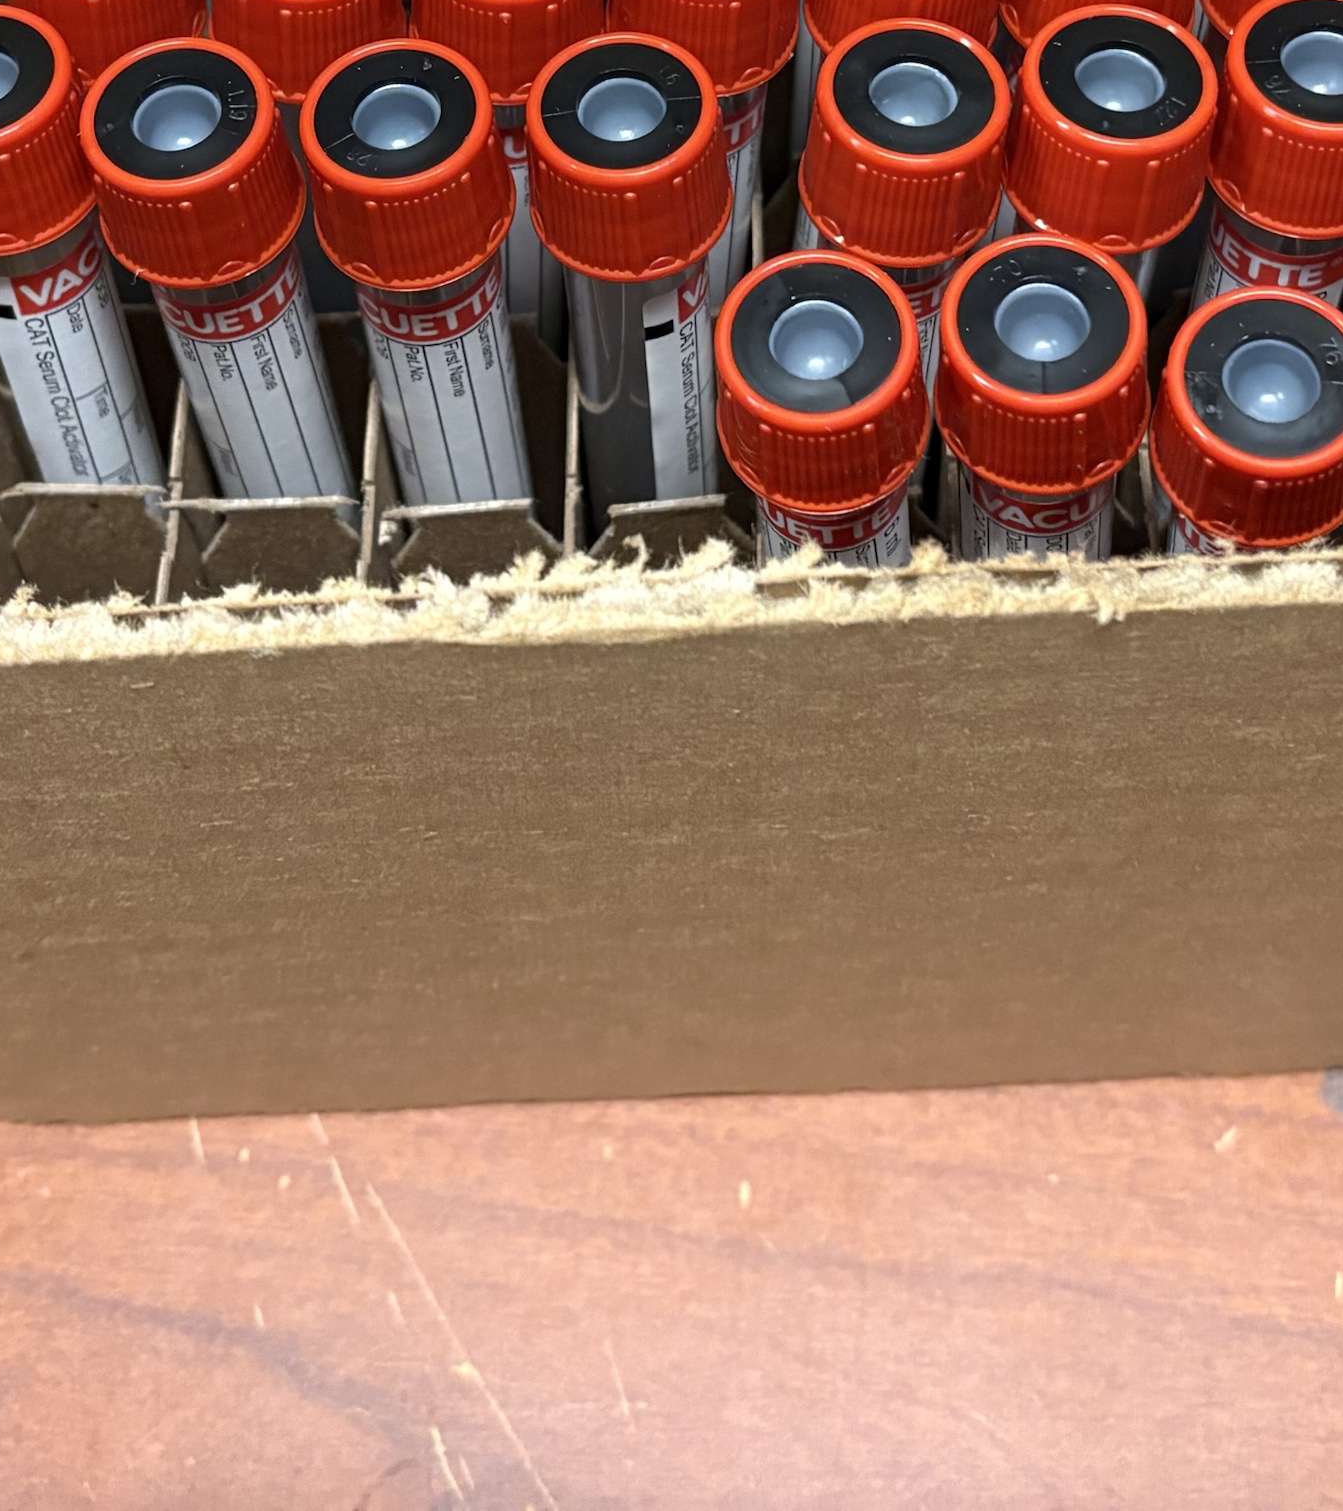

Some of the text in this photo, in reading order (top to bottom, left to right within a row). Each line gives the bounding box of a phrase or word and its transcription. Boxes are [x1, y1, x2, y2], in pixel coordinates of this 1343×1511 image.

[24, 317, 51, 347] CAT
[66, 302, 84, 333] Date
[679, 321, 695, 353] CAT
[36, 350, 63, 395] Serum
[760, 497, 893, 545] UETTE
[975, 481, 1100, 530] VACU
